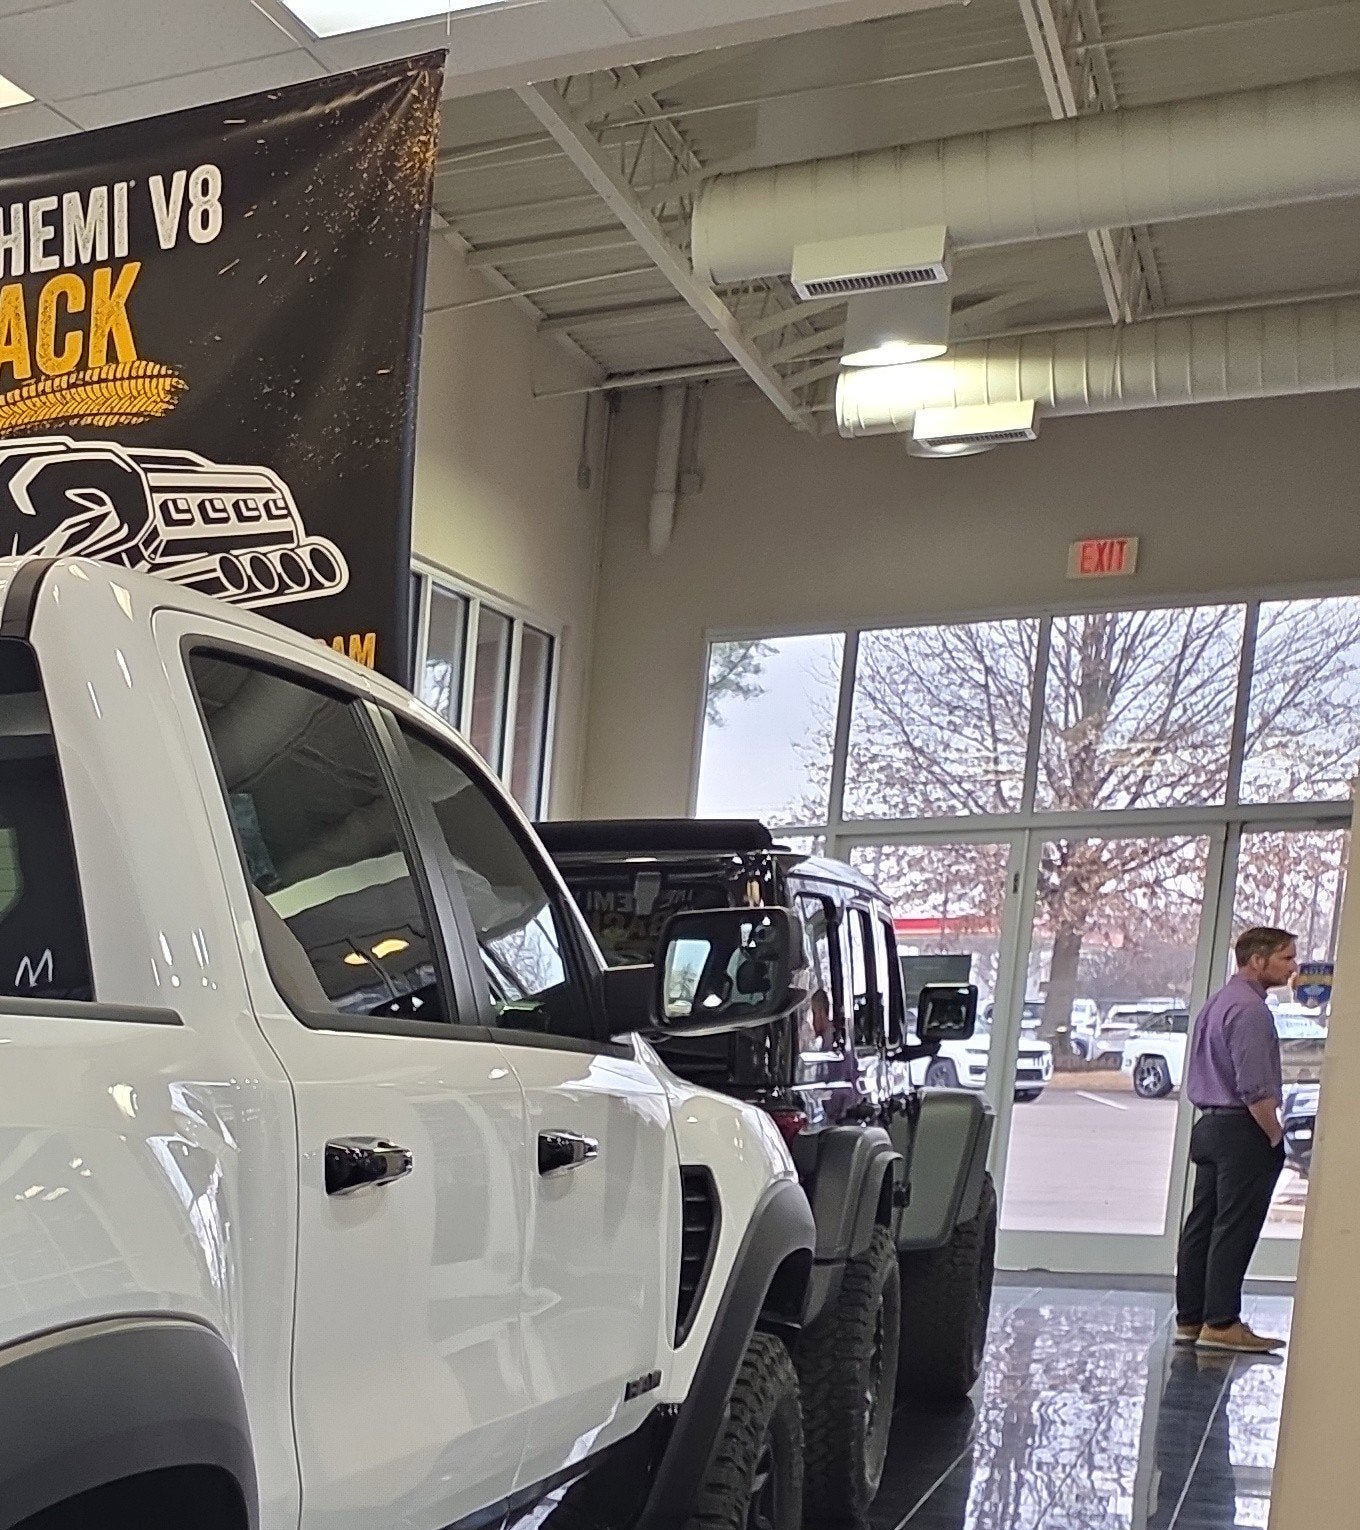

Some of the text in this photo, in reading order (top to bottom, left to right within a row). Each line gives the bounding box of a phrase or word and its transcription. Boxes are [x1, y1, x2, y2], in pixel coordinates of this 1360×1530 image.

[148, 163, 223, 250] V8
[1080, 540, 1128, 574] EXIT
[14, 948, 54, 988] M
